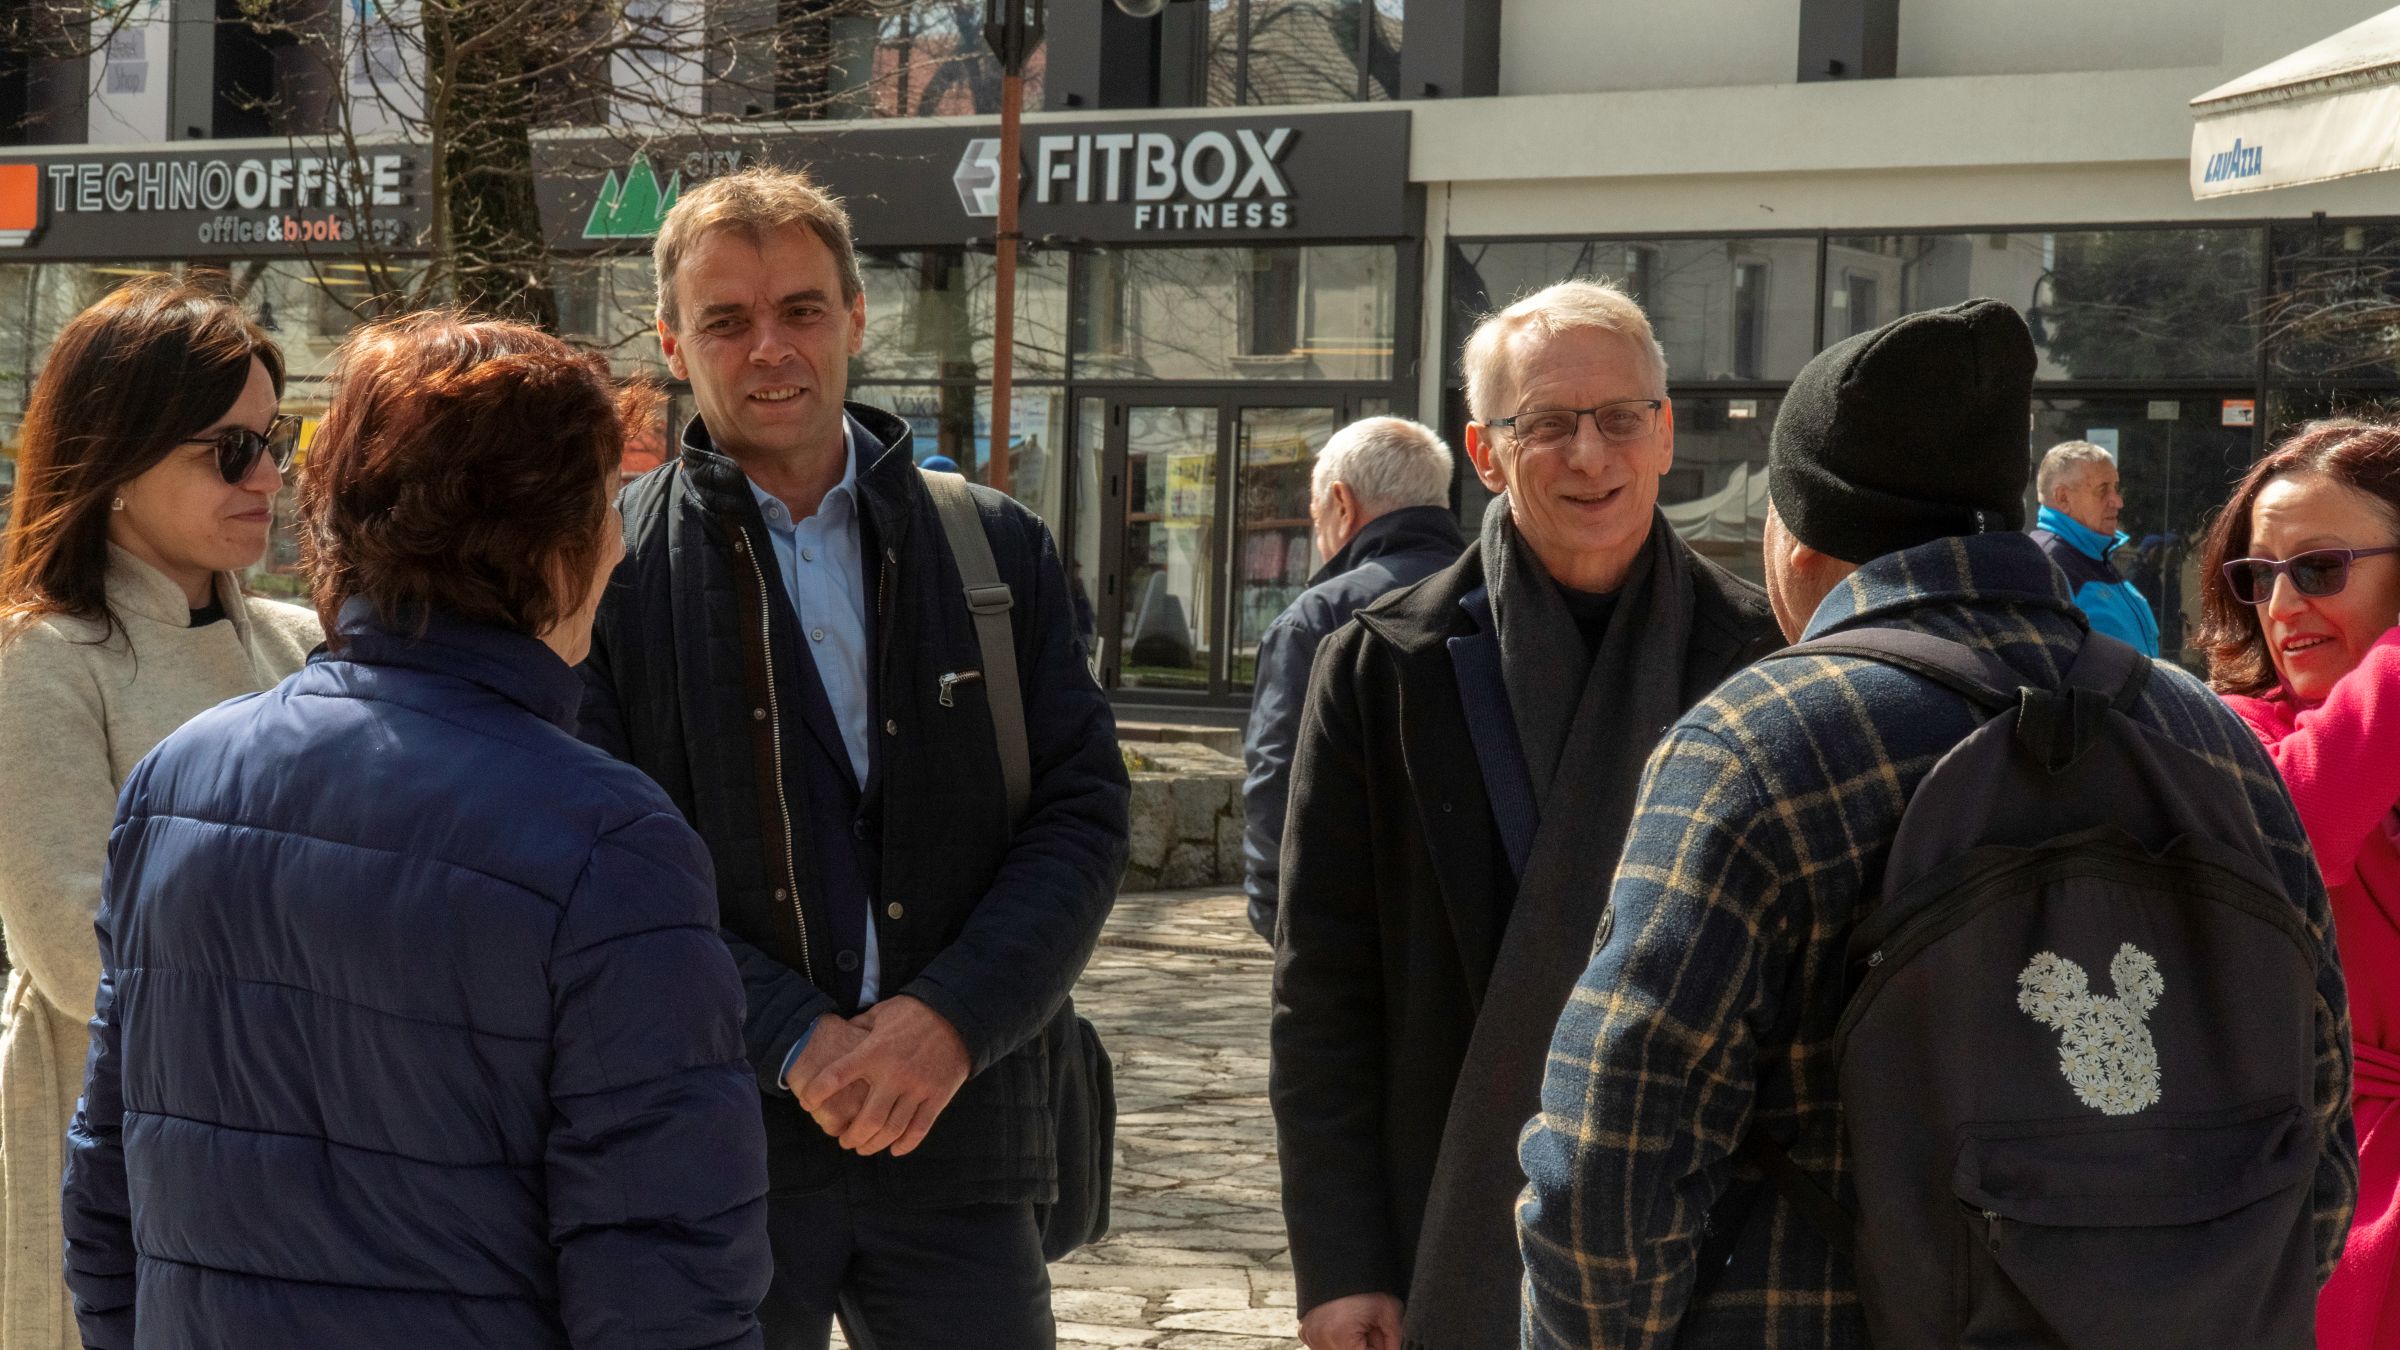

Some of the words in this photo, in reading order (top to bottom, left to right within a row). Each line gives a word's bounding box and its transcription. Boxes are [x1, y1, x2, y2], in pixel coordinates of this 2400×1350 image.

[685, 150, 742, 178] CITY
[1037, 128, 1290, 202] FITBOX
[2204, 138, 2263, 183] LAVAZZA
[48, 155, 402, 212] TECHNOOFFICE
[1135, 202, 1288, 230] FITNESS
